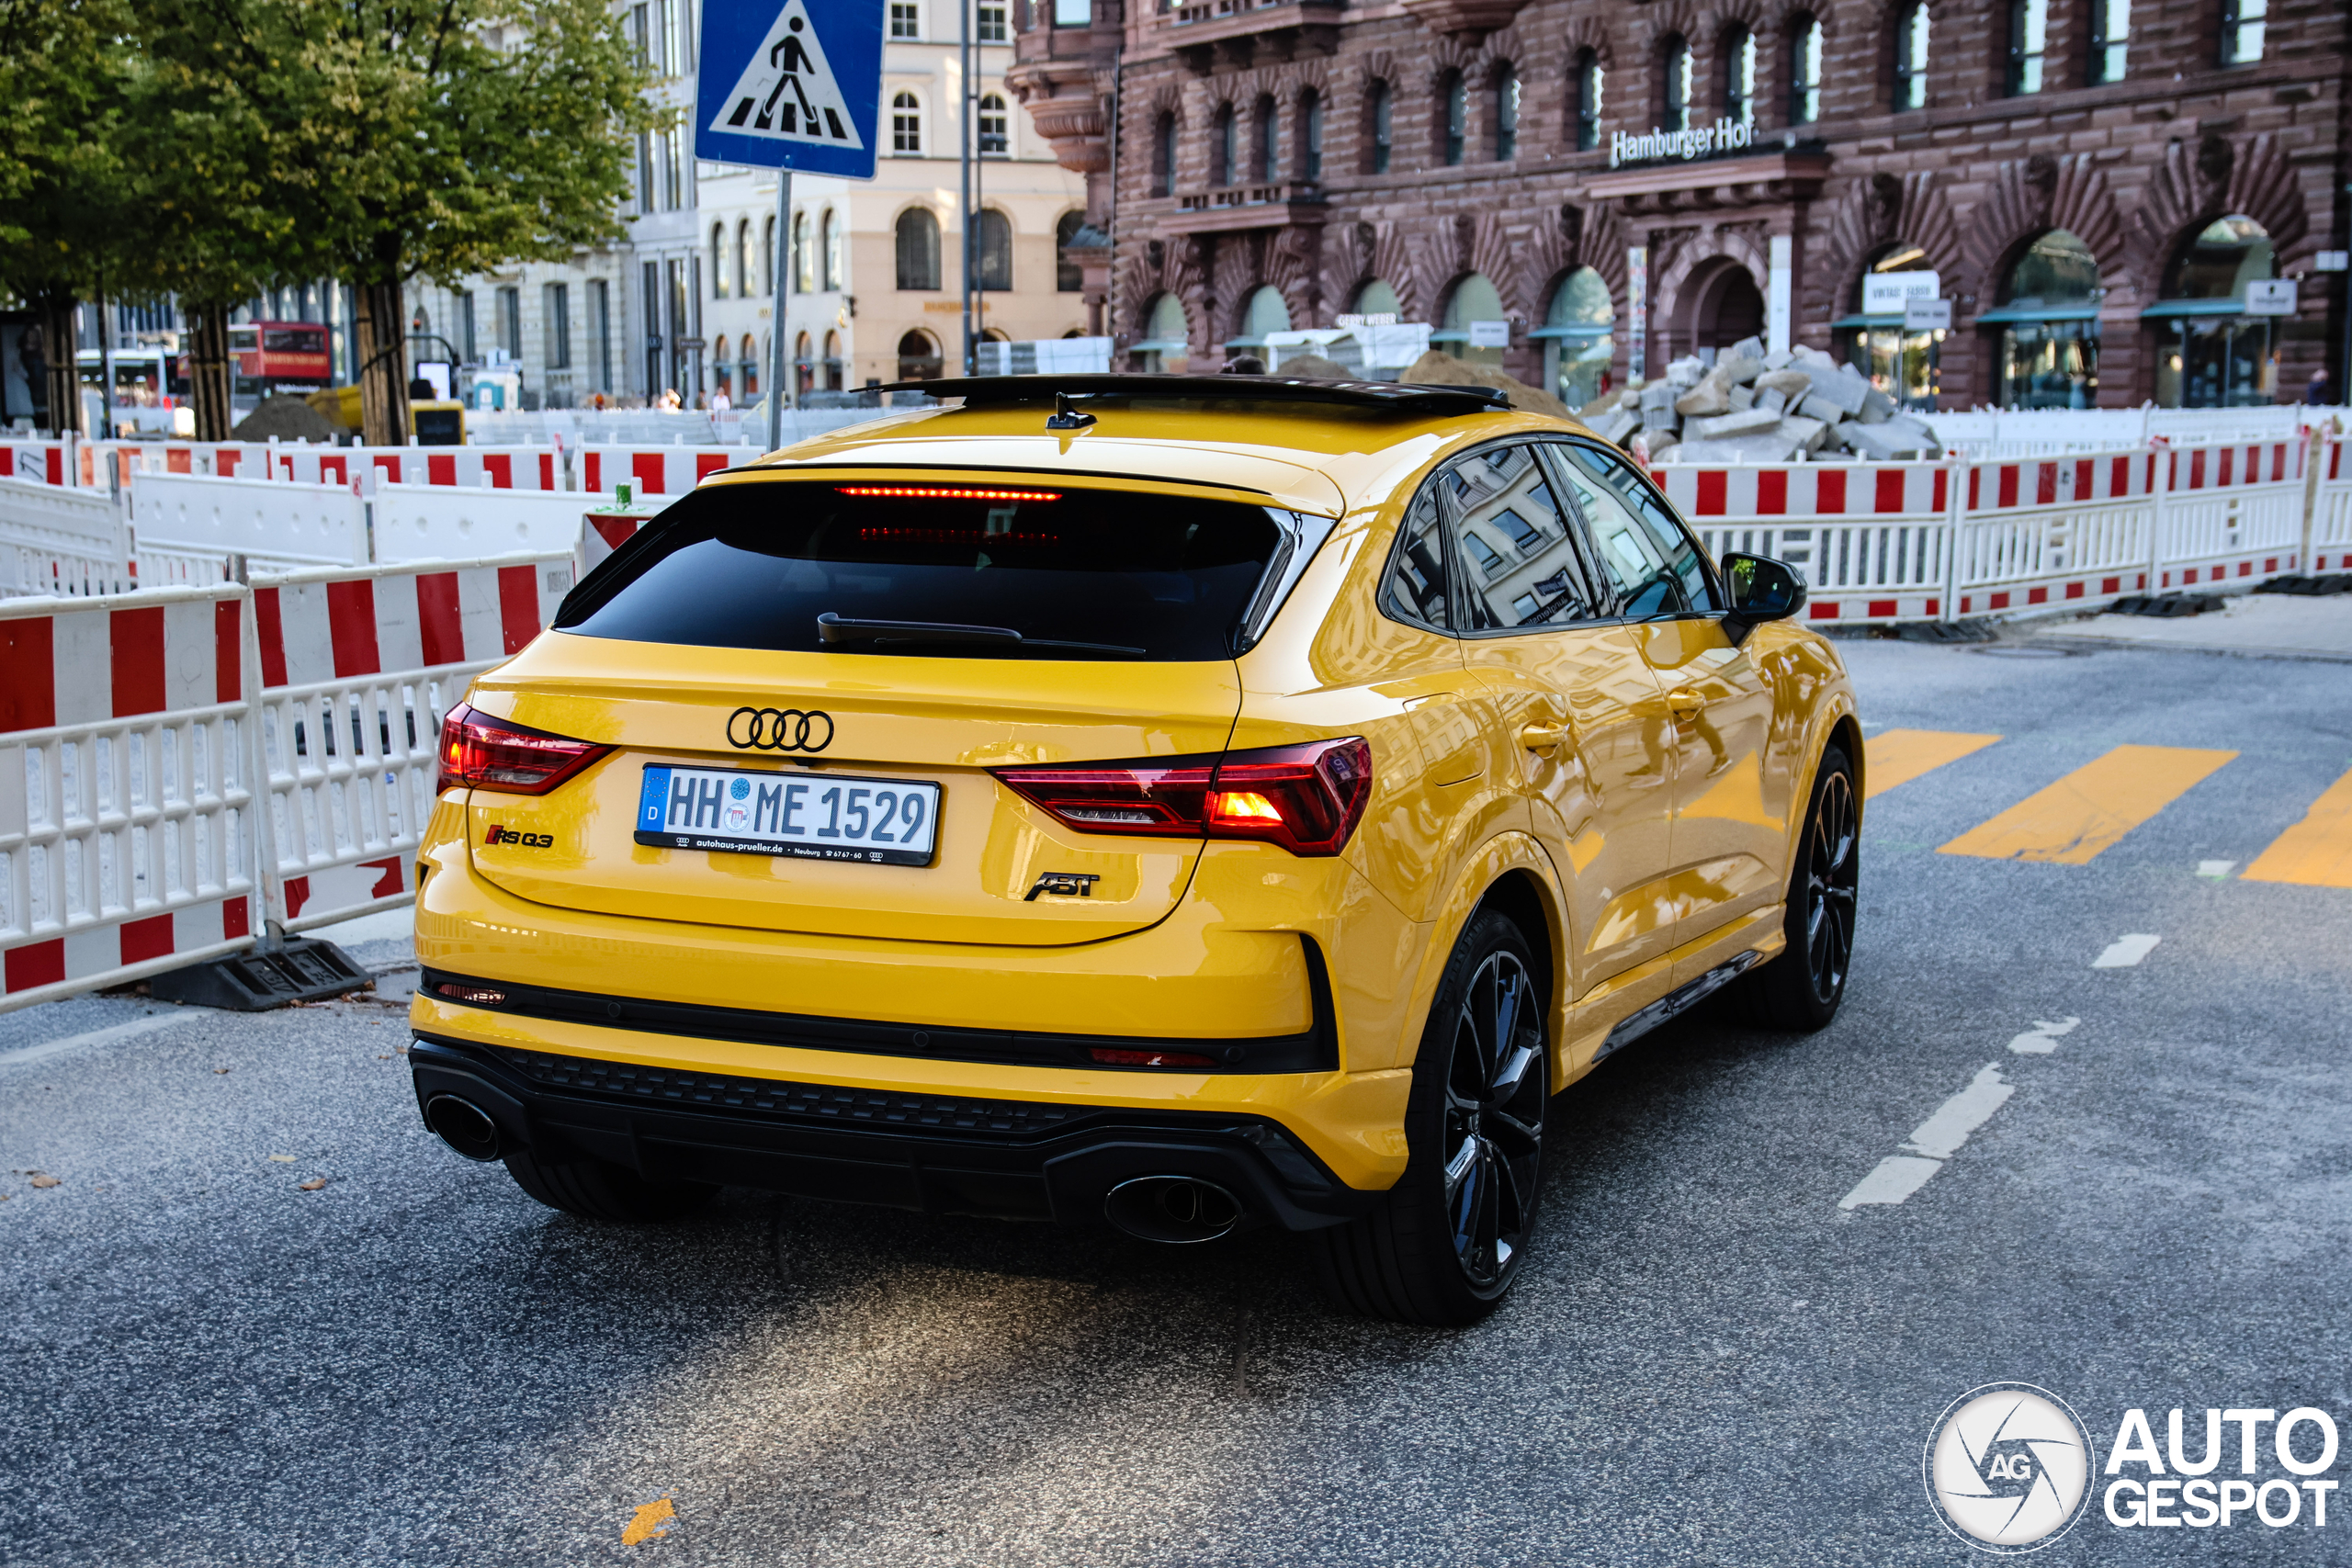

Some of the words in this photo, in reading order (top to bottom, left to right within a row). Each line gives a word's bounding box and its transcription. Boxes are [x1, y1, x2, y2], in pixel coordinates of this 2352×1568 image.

[1610, 126, 1715, 164] Hamburger
[1715, 117, 1754, 151] Hof
[1366, 311, 1396, 327] WEBER
[648, 807, 658, 820] D
[667, 776, 725, 829] HH
[753, 783, 809, 835] ME
[817, 786, 926, 843] 1529
[521, 832, 554, 848] Q3
[696, 839, 784, 853] autohaus-prueller.de
[794, 847, 821, 857] Neuburg
[1023, 871, 1101, 901] ABT
